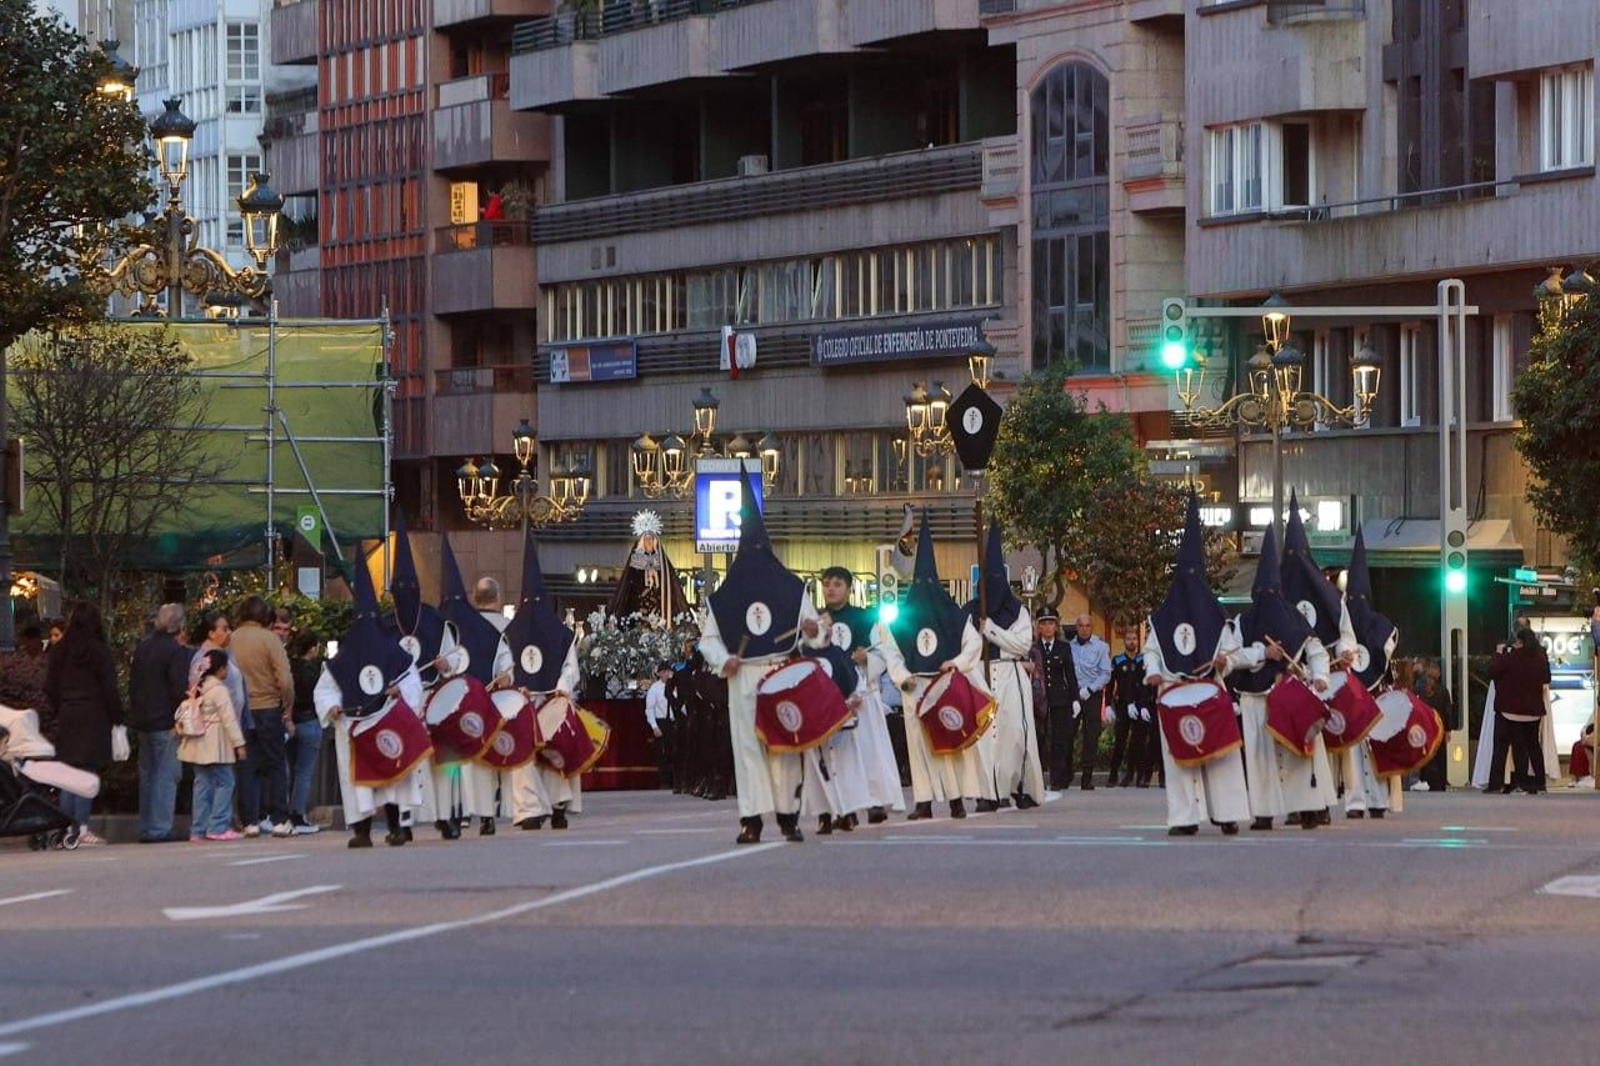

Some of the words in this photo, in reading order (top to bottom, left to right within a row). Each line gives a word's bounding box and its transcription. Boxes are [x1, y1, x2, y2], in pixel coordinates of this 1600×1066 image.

[823, 338, 848, 358] COLEGIO
[850, 335, 873, 357] OFICIAL
[874, 334, 882, 354] DE
[884, 327, 924, 353] ENFERMERÍA
[926, 330, 934, 349] DE
[935, 326, 978, 348] PONTEVEDRA
[700, 542, 736, 552] Abierto
